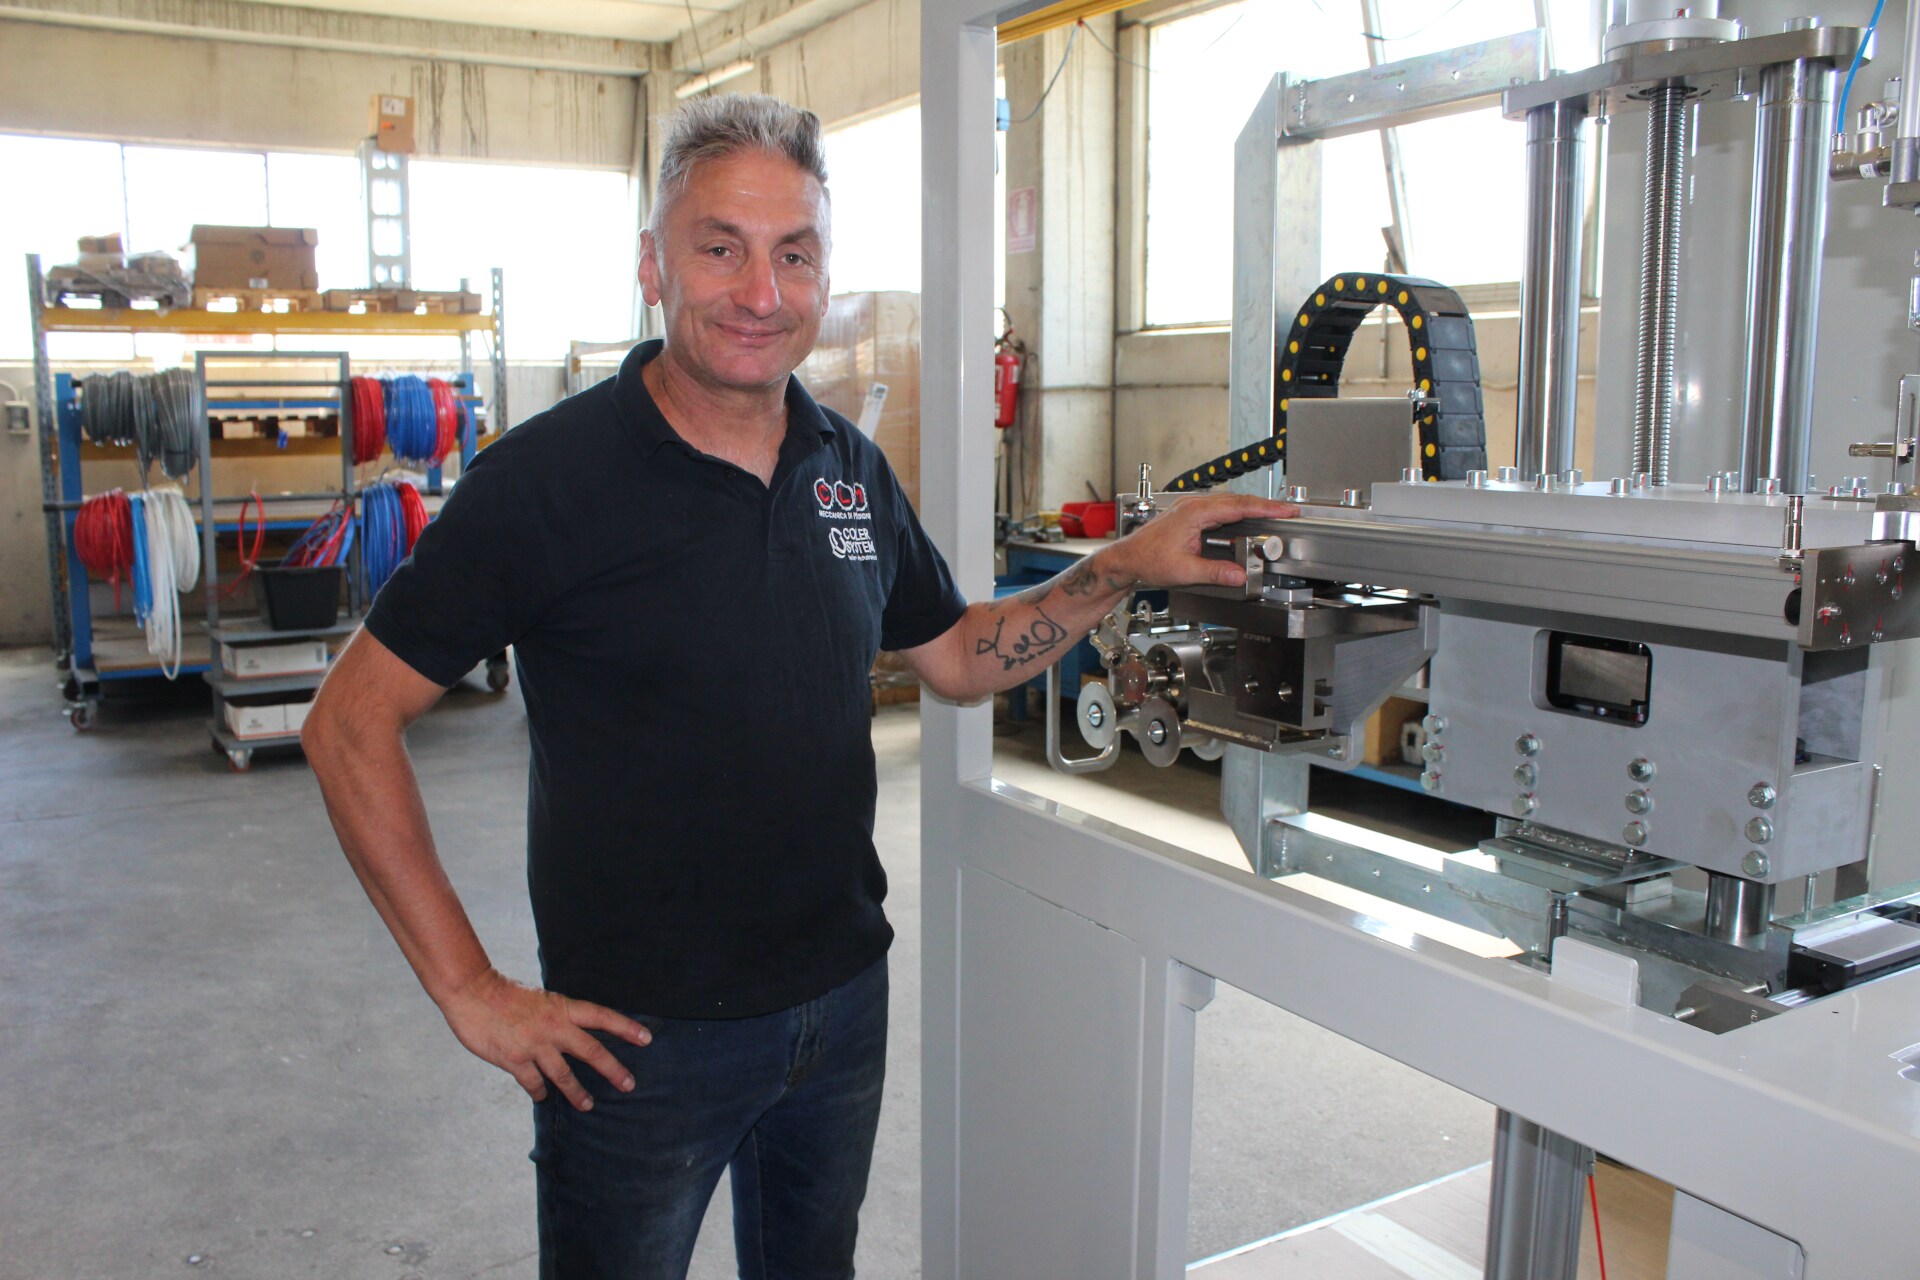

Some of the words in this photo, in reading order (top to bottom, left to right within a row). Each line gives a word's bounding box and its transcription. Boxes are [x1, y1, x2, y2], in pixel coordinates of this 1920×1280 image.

[818, 509, 847, 520] MECCANICA
[847, 511, 853, 520] DI
[843, 527, 871, 541] COLER
[846, 540, 876, 554] SYSTEM
